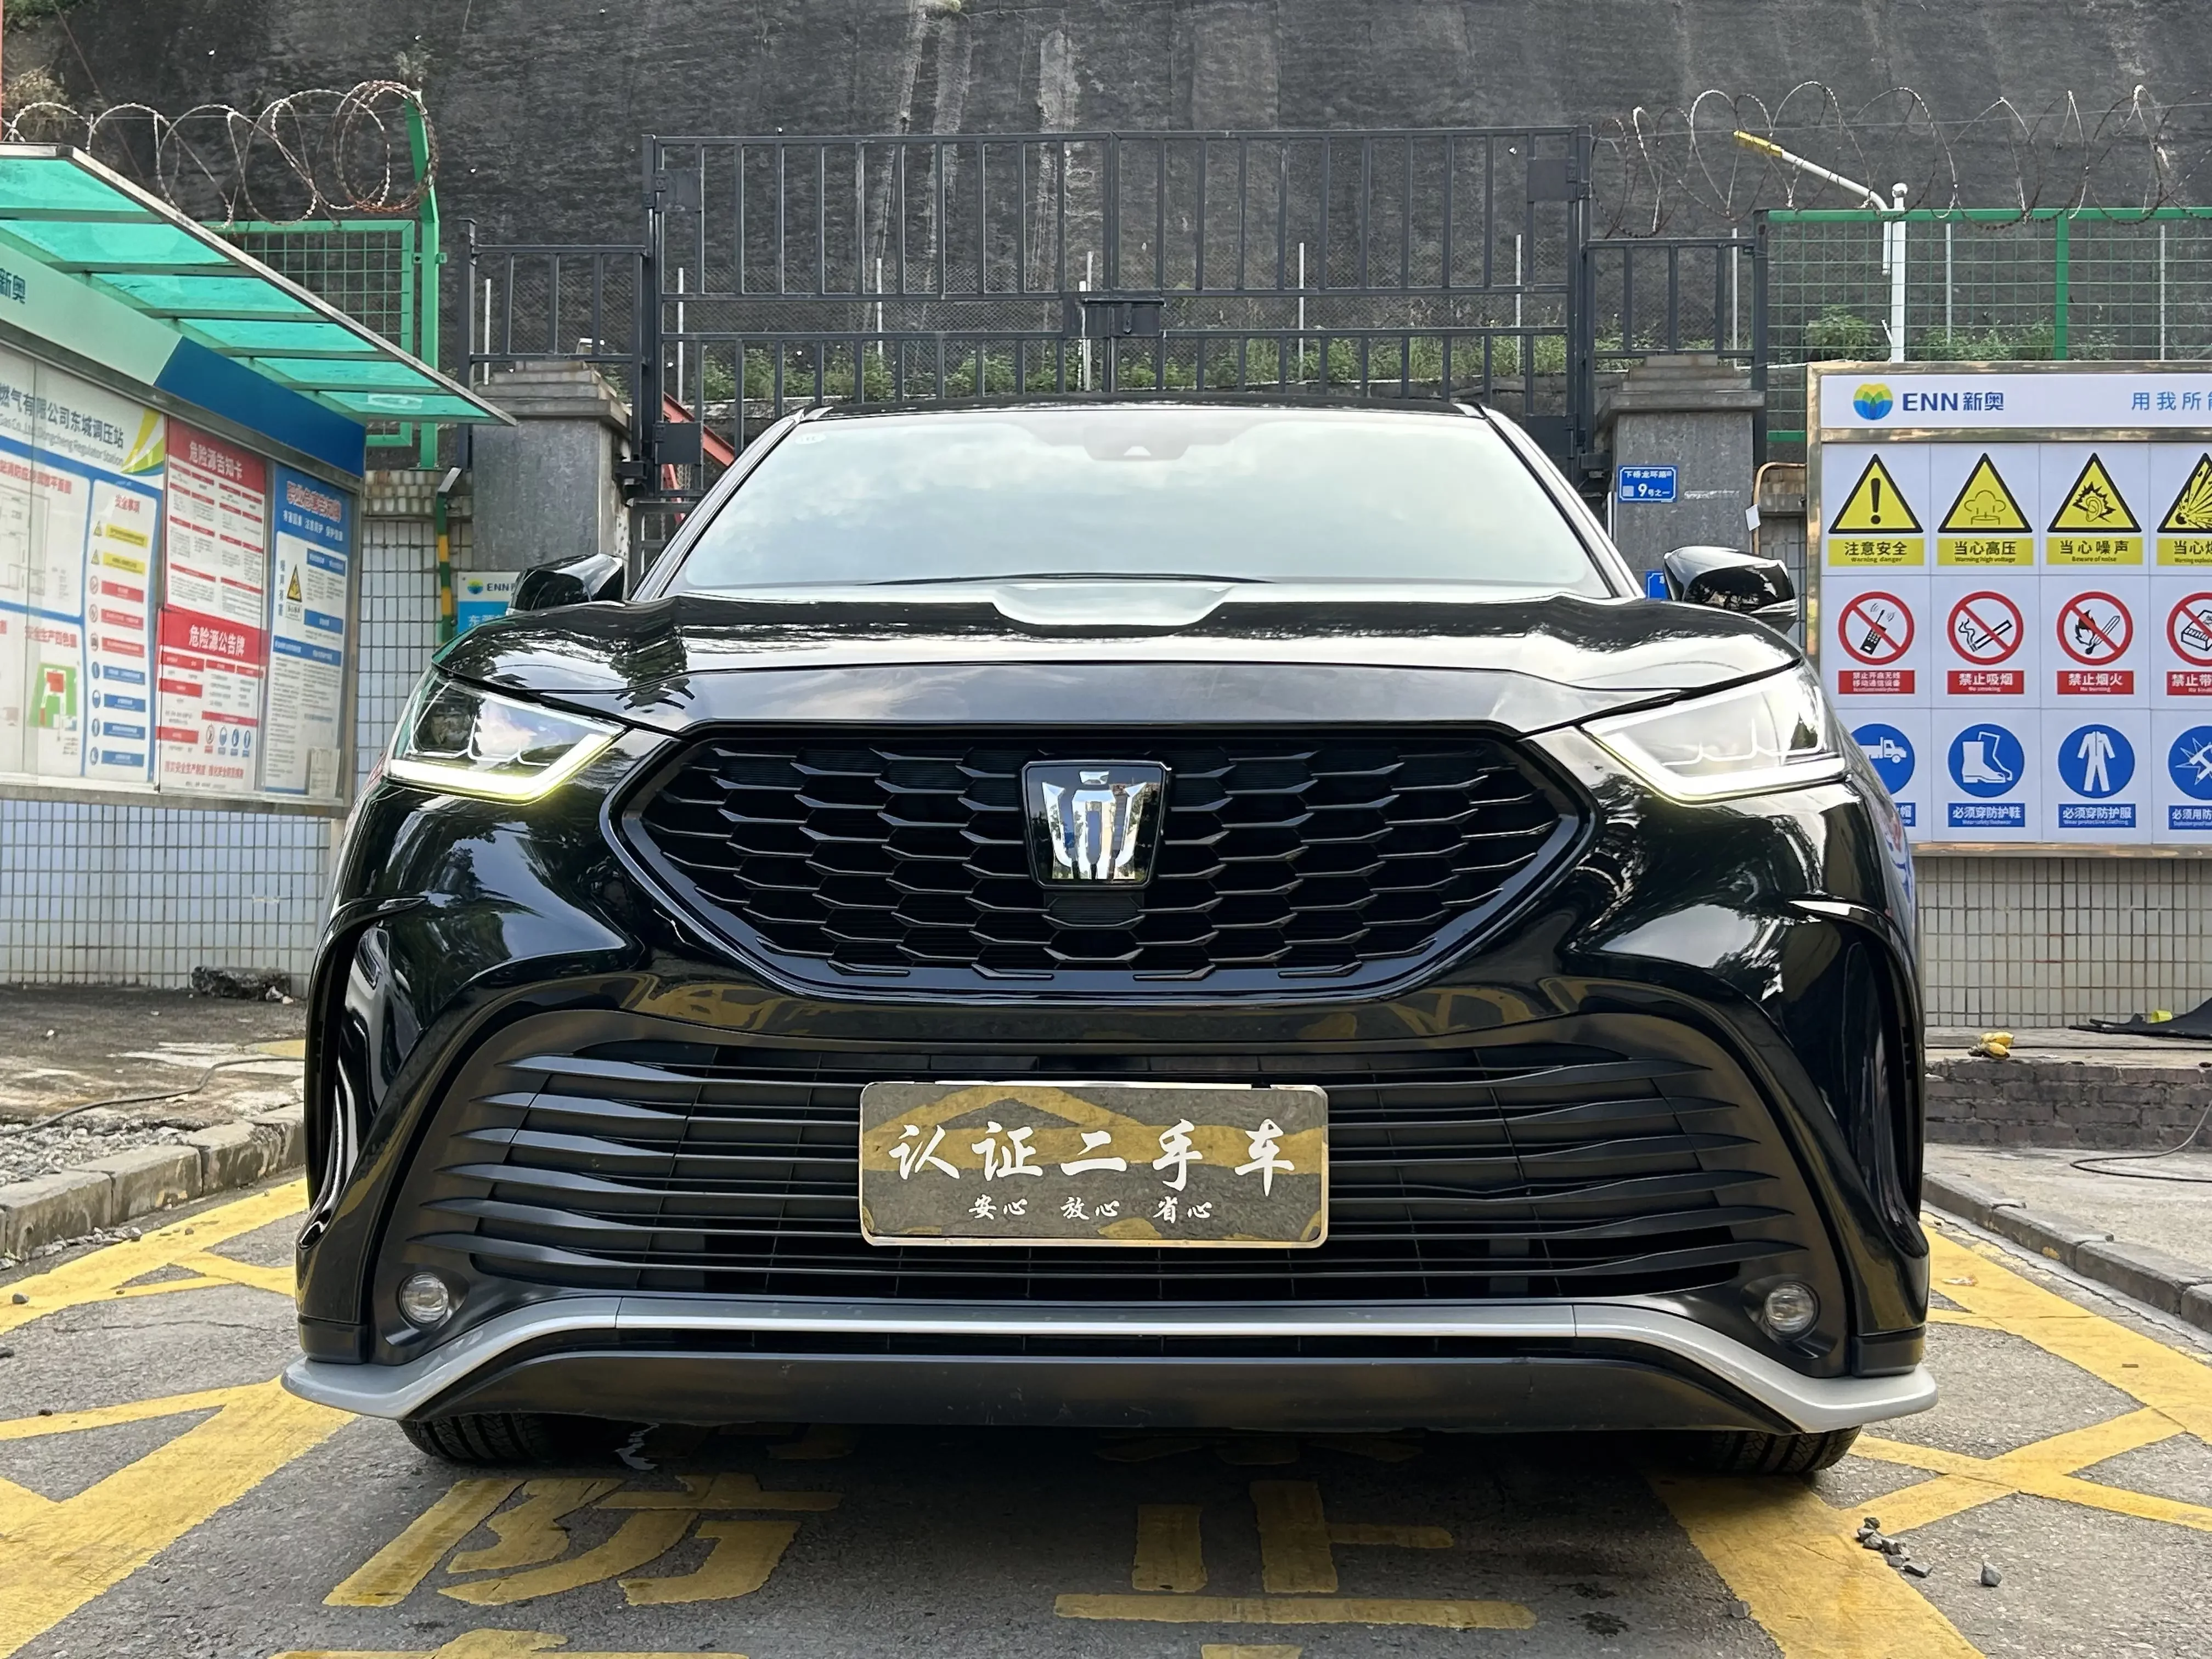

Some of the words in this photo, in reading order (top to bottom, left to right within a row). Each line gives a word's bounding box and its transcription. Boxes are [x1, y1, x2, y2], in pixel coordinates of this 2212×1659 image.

[2131, 392, 2212, 411] 用我所
[1638, 483, 1671, 497] 9号之一
[1844, 541, 1908, 556] 注意安全
[1954, 541, 2017, 555] 当心高压
[2060, 540, 2129, 555] 当心噪声
[189, 624, 245, 657] 危险源公告牌
[1959, 673, 2013, 686] 禁止吸烟
[2068, 673, 2124, 686] 禁止烟火
[1953, 806, 2021, 819] 必须穿防护鞋
[2063, 807, 2132, 819] 必须穿防护服
[888, 1119, 1296, 1197] 认证二手车
[968, 1194, 1028, 1221] 安心
[1060, 1196, 1120, 1221] 放心
[1153, 1198, 1213, 1224] 省心
